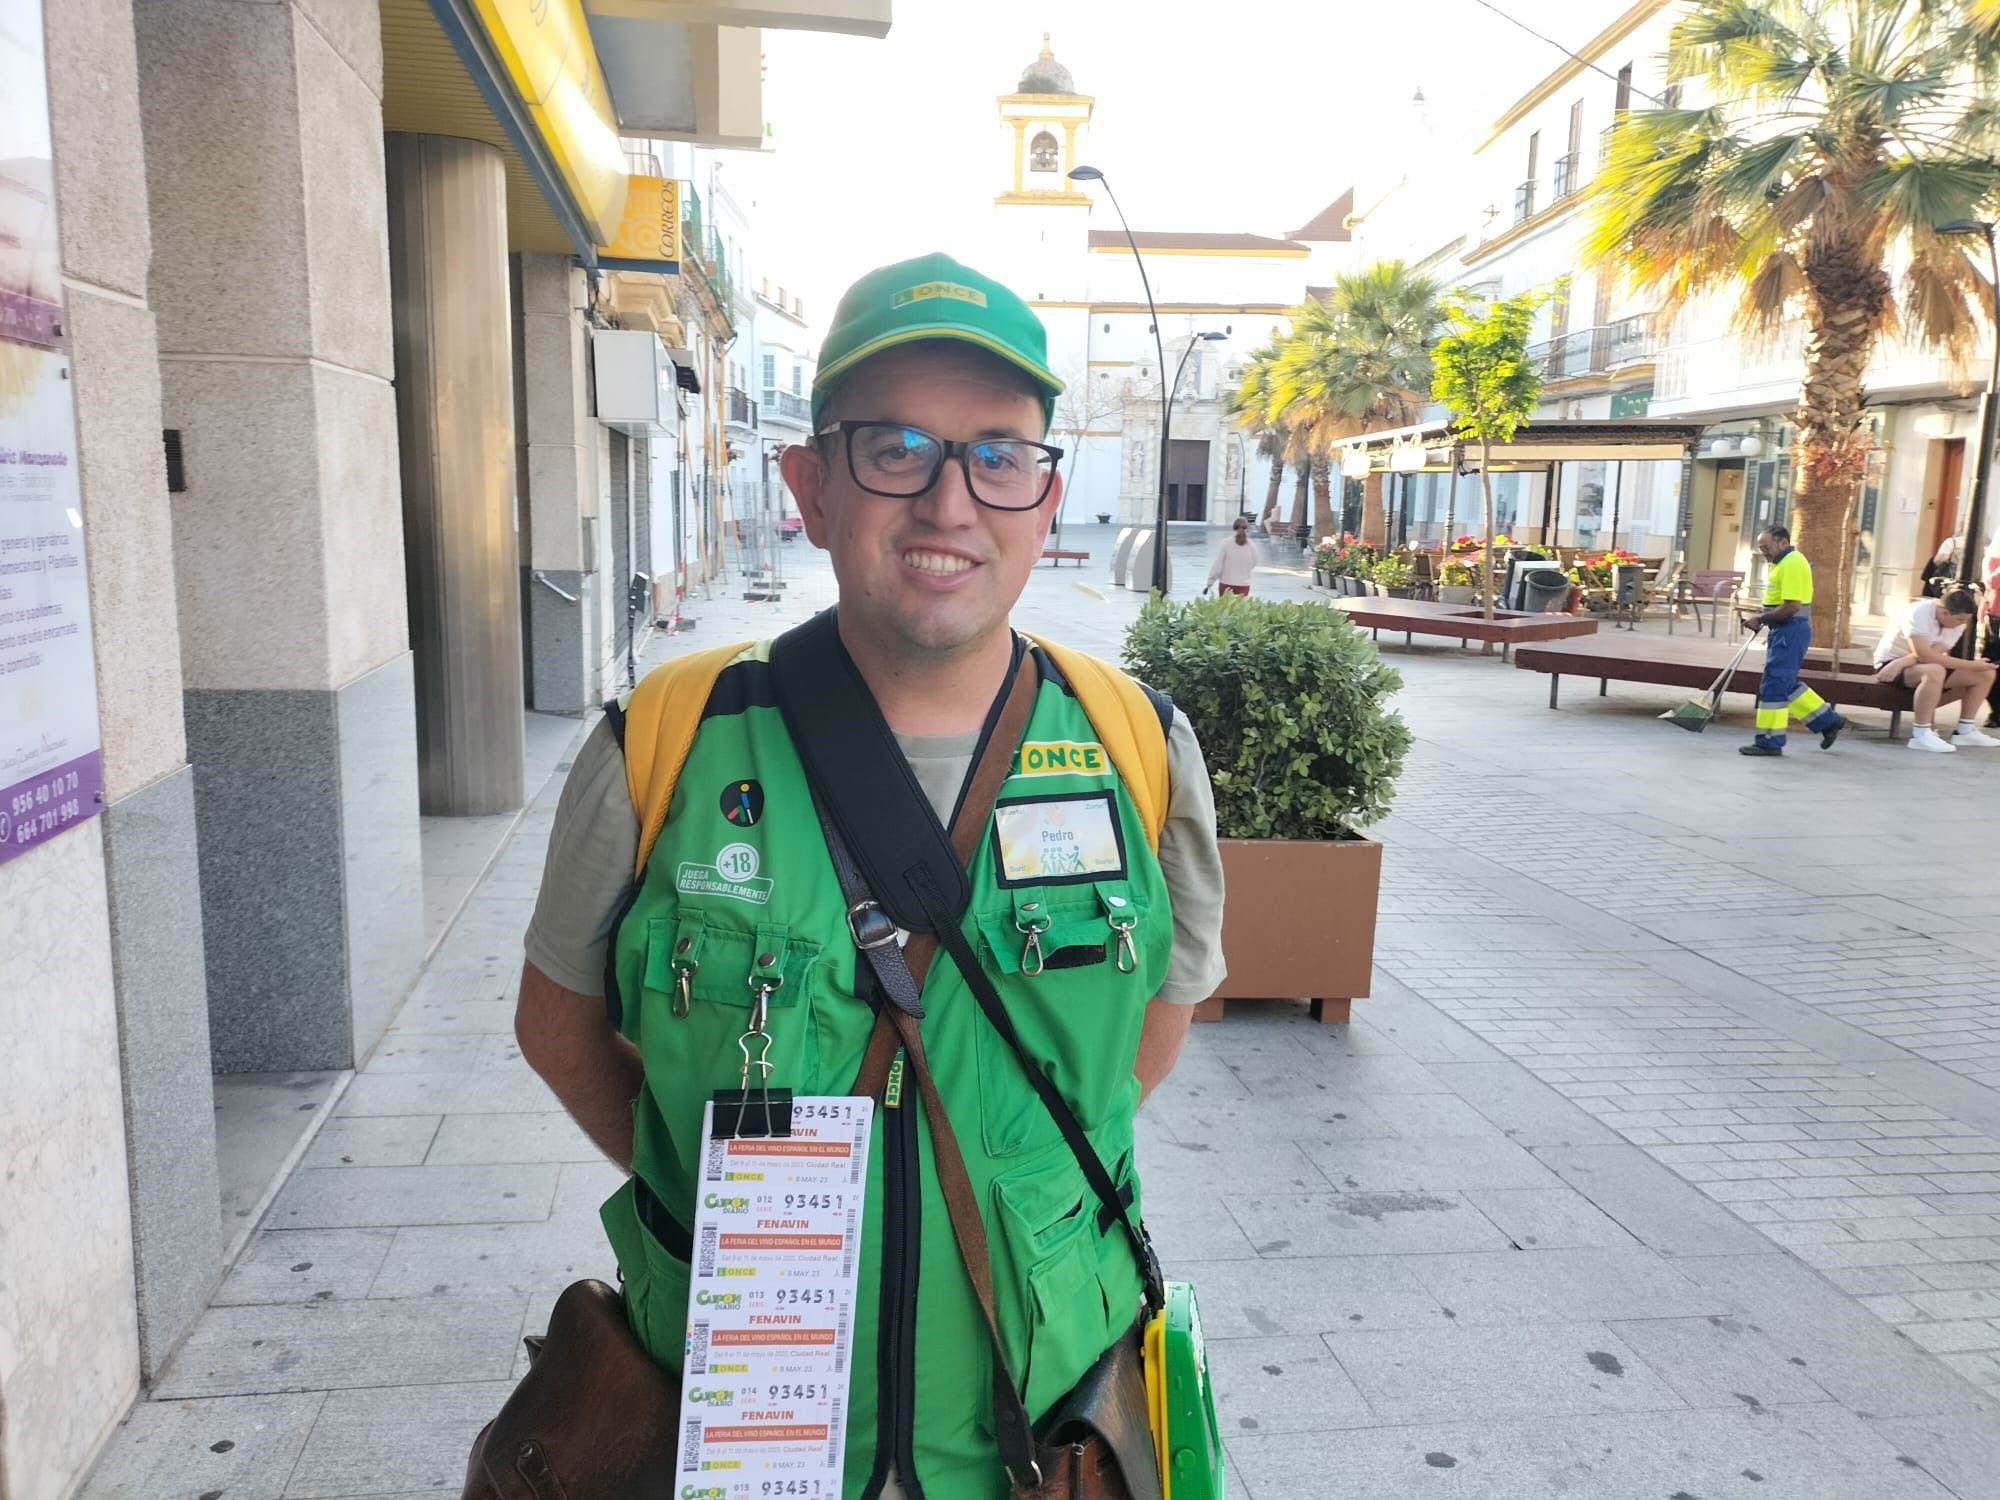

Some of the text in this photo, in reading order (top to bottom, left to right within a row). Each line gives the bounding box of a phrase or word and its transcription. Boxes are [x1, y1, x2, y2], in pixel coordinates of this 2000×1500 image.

[1028, 747, 1102, 769] ONCE
[12, 771, 79, 817] 956 40 10 70
[16, 818, 38, 844] 664
[39, 808, 58, 833] 701
[1042, 829, 1074, 842] Pedro
[722, 852, 751, 874] +18
[682, 869, 709, 880] JUEGA
[680, 879, 768, 901] RESPONSABLEMENTE
[888, 1062, 901, 1104] ONCE
[793, 1105, 852, 1120] 93451
[757, 1195, 772, 1203] 012
[784, 1194, 843, 1209] 93451
[757, 1219, 809, 1229] FENAVIN
[749, 1291, 764, 1299] 013
[776, 1289, 834, 1304] 93451
[749, 1315, 801, 1324] FENAVIN
[741, 1387, 757, 1395] 014
[768, 1384, 827, 1399] 93451
[742, 1410, 794, 1421] FENAVIN
[734, 1483, 749, 1491] 015
[762, 1480, 820, 1495] 93451
